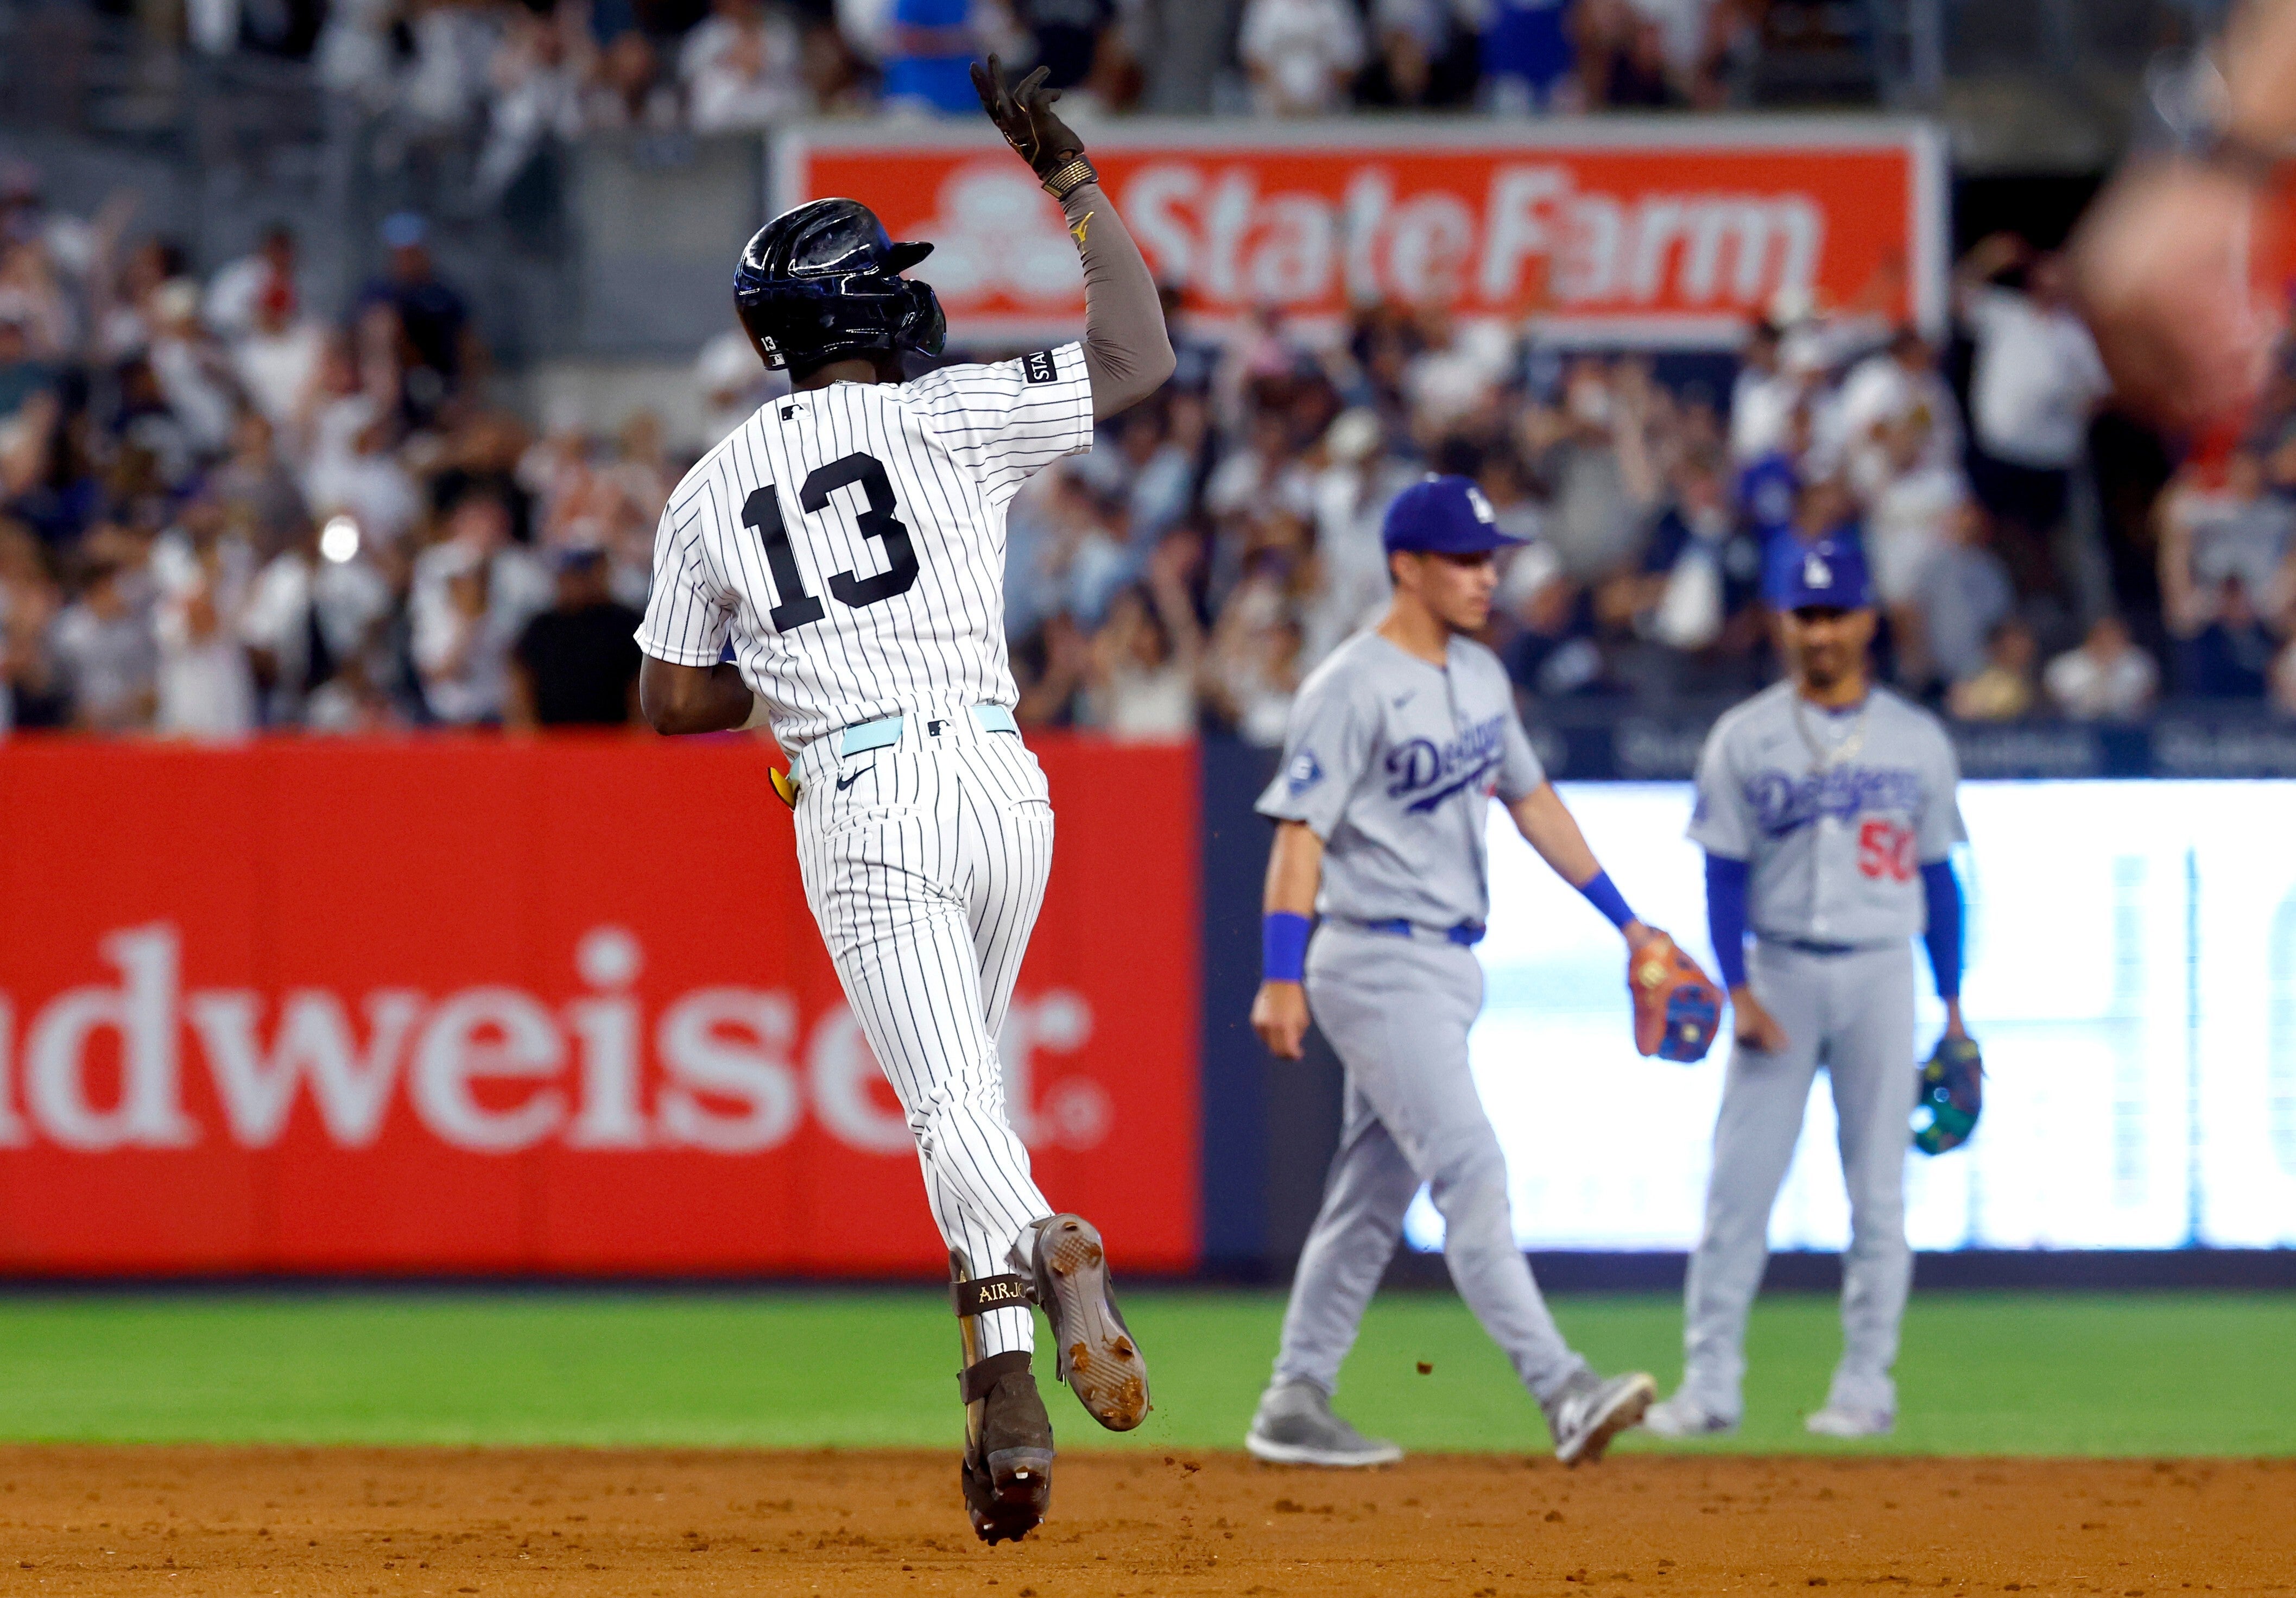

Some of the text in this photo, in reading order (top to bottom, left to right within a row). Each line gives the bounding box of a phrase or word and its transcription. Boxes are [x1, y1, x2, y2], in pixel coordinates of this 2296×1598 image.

[761, 336, 776, 351] 13
[741, 451, 920, 634] 13
[1857, 819, 1918, 884] 50
